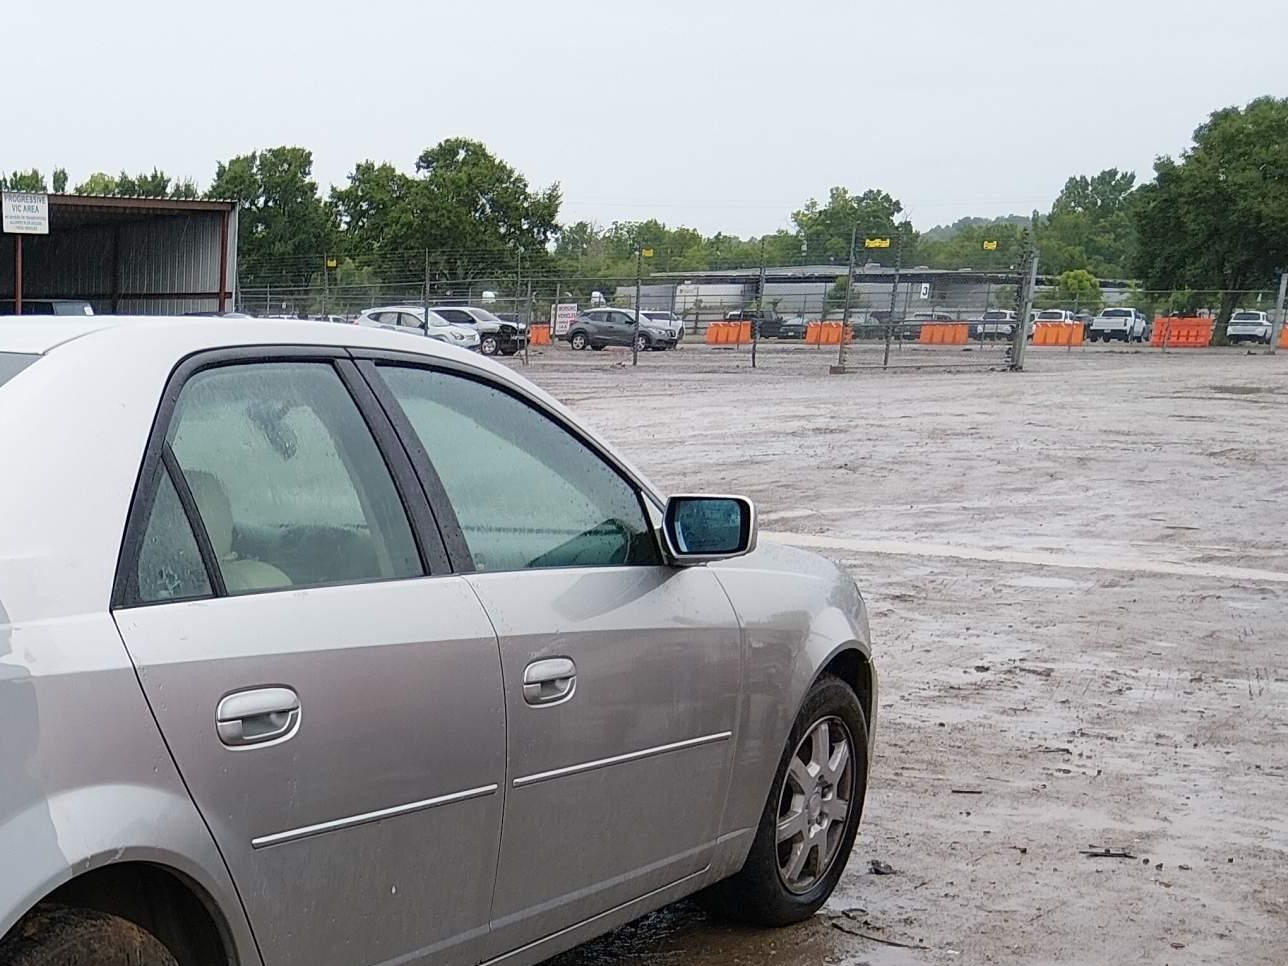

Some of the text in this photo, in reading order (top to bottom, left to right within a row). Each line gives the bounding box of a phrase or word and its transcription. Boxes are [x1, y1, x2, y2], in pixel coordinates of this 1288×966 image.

[4, 194, 46, 204] PROGRESSIVE
[12, 204, 39, 213] VIC AREA
